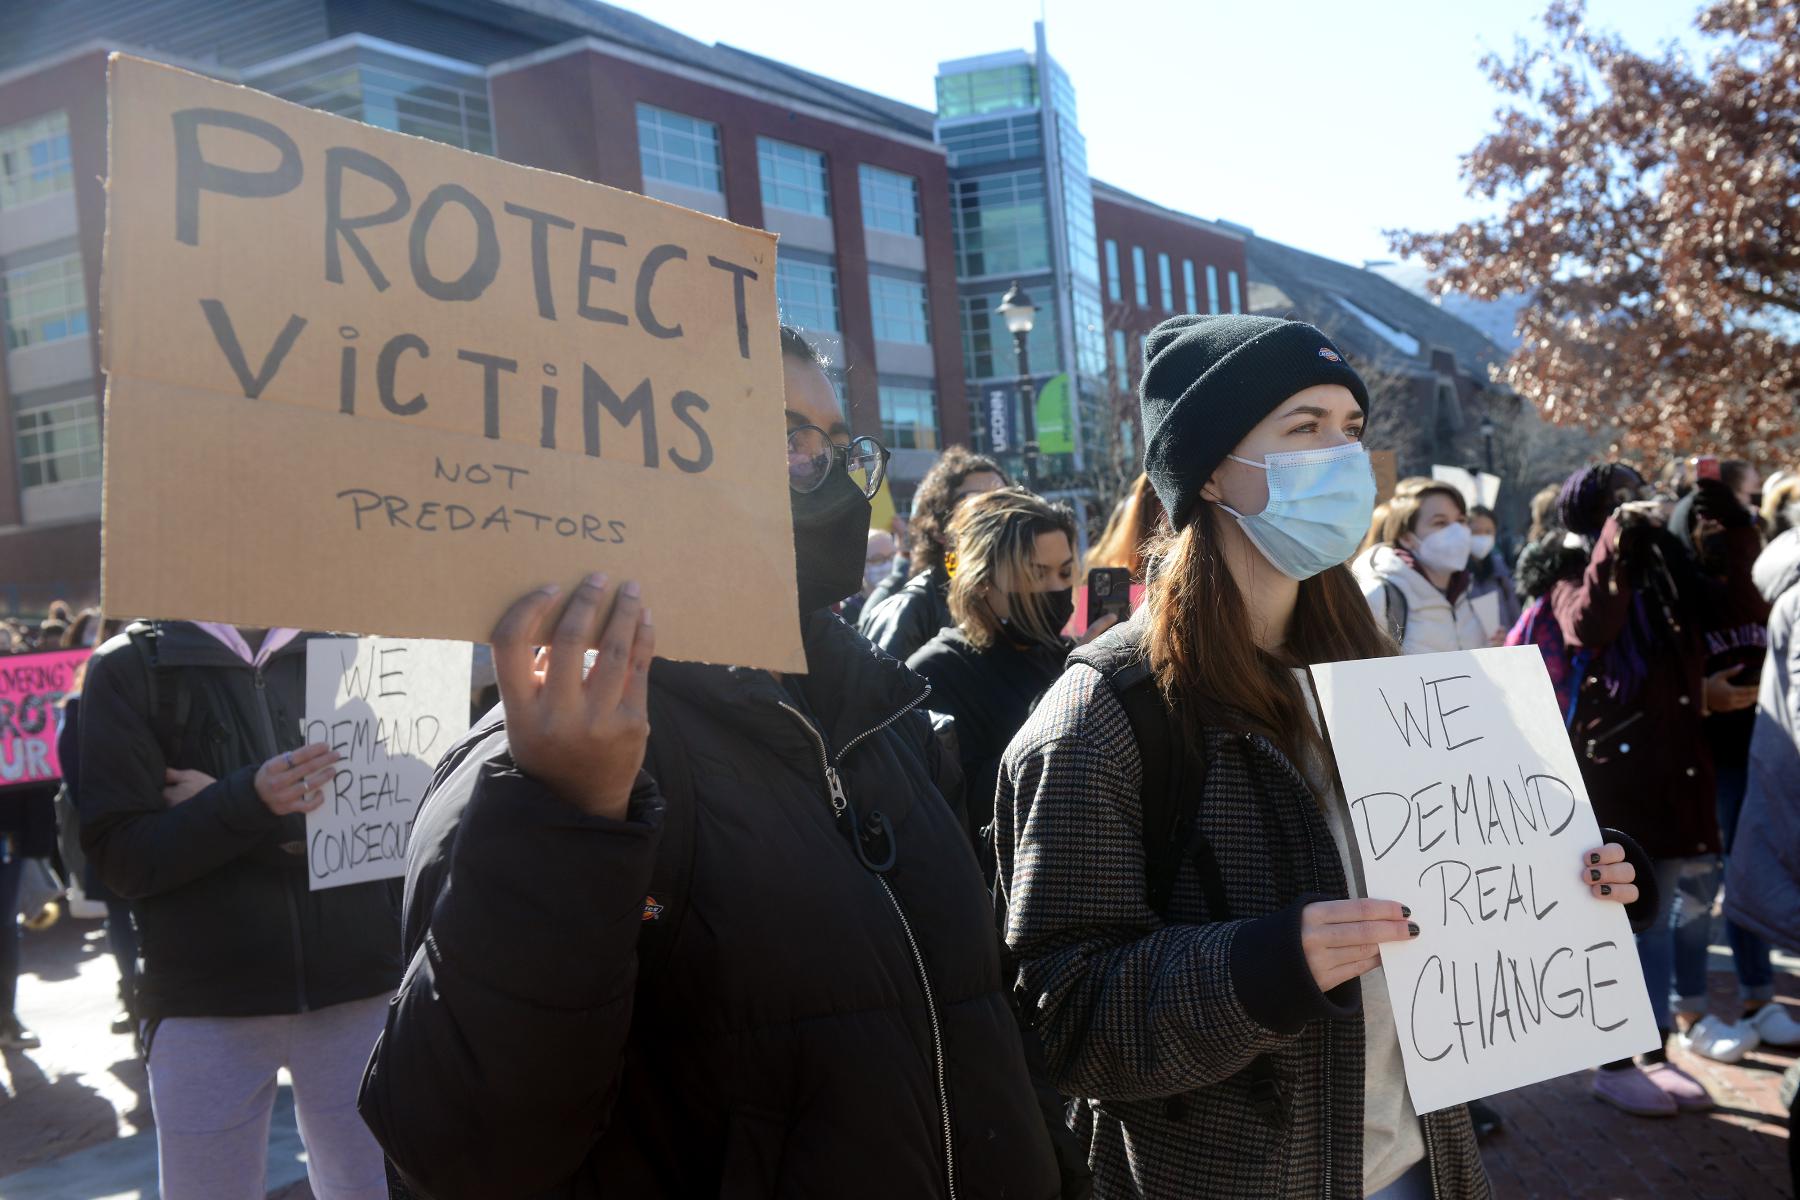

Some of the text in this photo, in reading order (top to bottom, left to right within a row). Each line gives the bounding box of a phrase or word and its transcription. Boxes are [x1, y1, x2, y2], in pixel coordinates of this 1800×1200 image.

[172, 107, 758, 360] PROTECT
[435, 456, 530, 490] NOT
[336, 489, 627, 545] PREDATORS
[340, 645, 407, 701] WE
[307, 715, 440, 765] DEMAND
[1378, 675, 1485, 751] WE
[333, 769, 412, 817] REAL
[1351, 764, 1576, 861] DEMAND
[1418, 860, 1559, 927] REAL
[1410, 940, 1629, 1064] CHANGE
